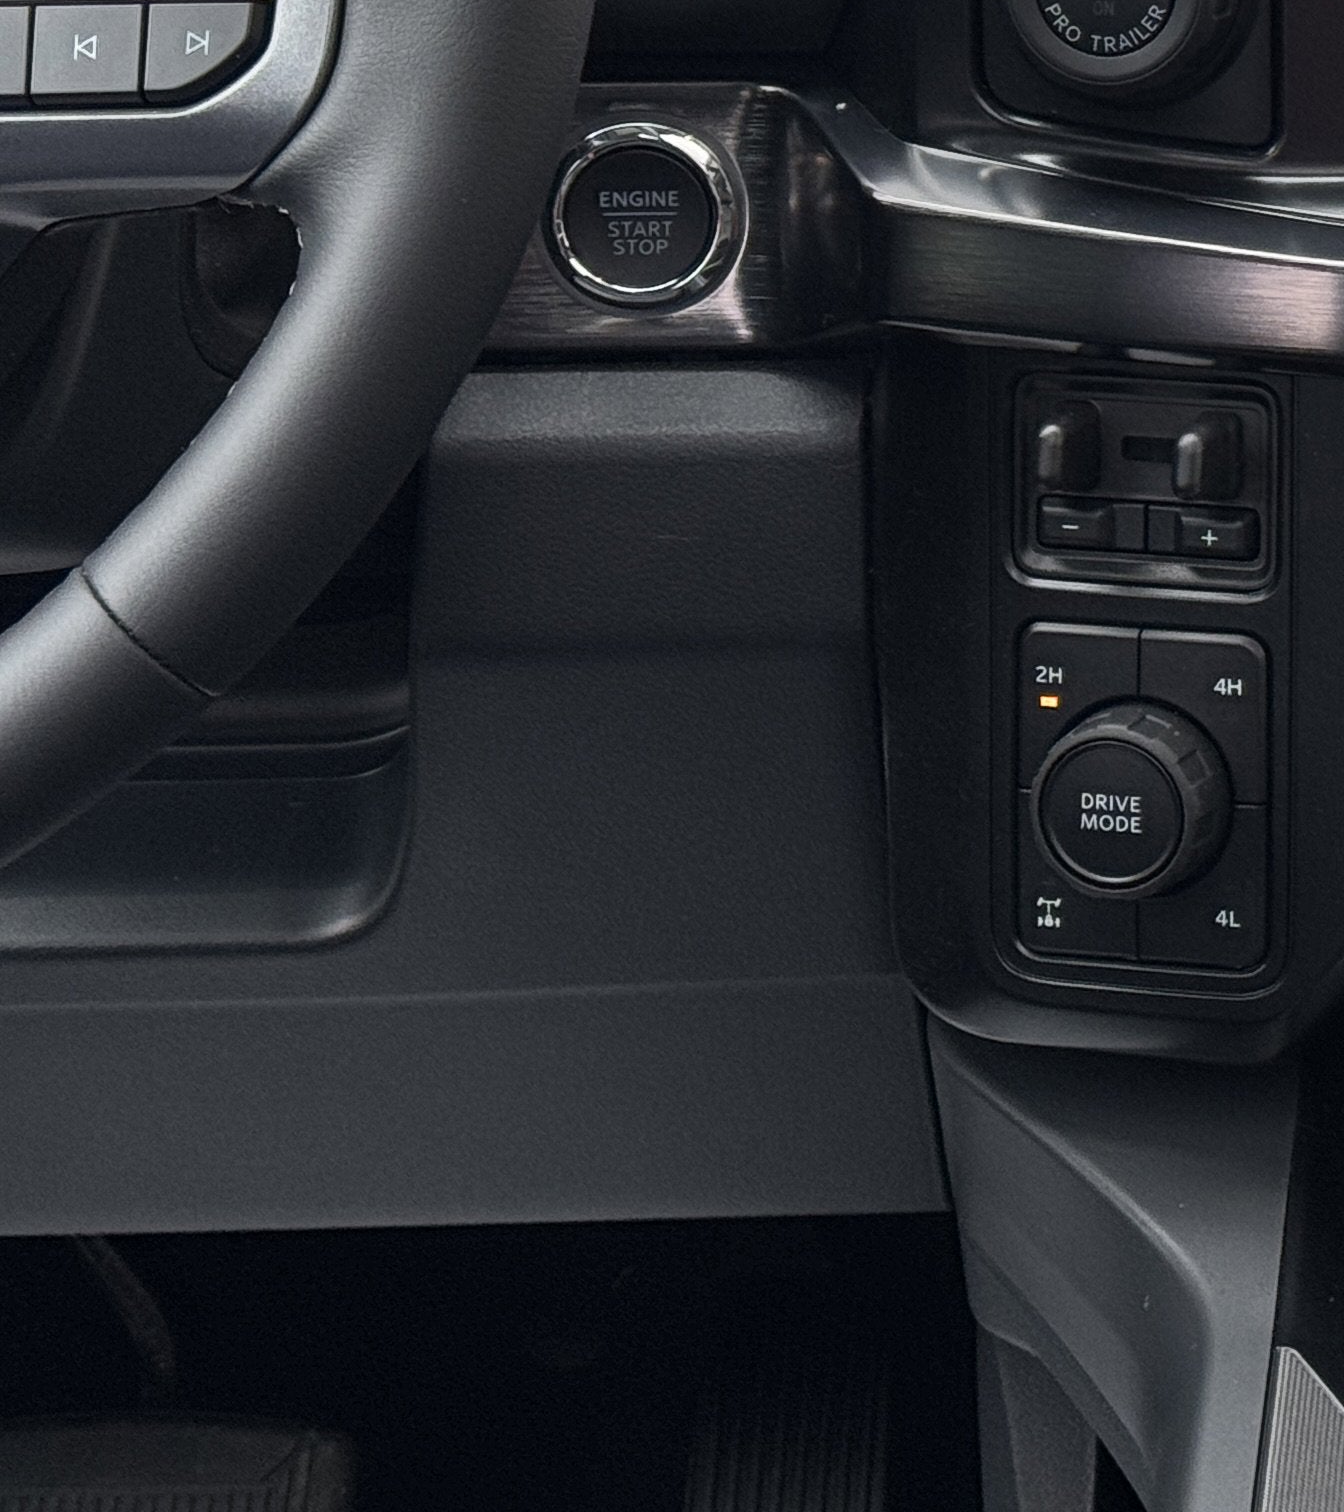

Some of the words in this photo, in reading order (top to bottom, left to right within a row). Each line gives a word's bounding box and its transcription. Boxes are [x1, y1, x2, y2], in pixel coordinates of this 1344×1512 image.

[1043, 1, 1082, 43] PRO
[1090, 4, 1167, 53] TRAILER
[599, 190, 680, 208] ENGINE
[607, 220, 673, 238] START
[613, 238, 669, 256] STOP
[1035, 665, 1063, 684] 2H
[1213, 678, 1243, 696] 4H
[1081, 792, 1141, 813] DRIVE
[1080, 813, 1142, 834] MODE
[1215, 909, 1241, 928] 4L
